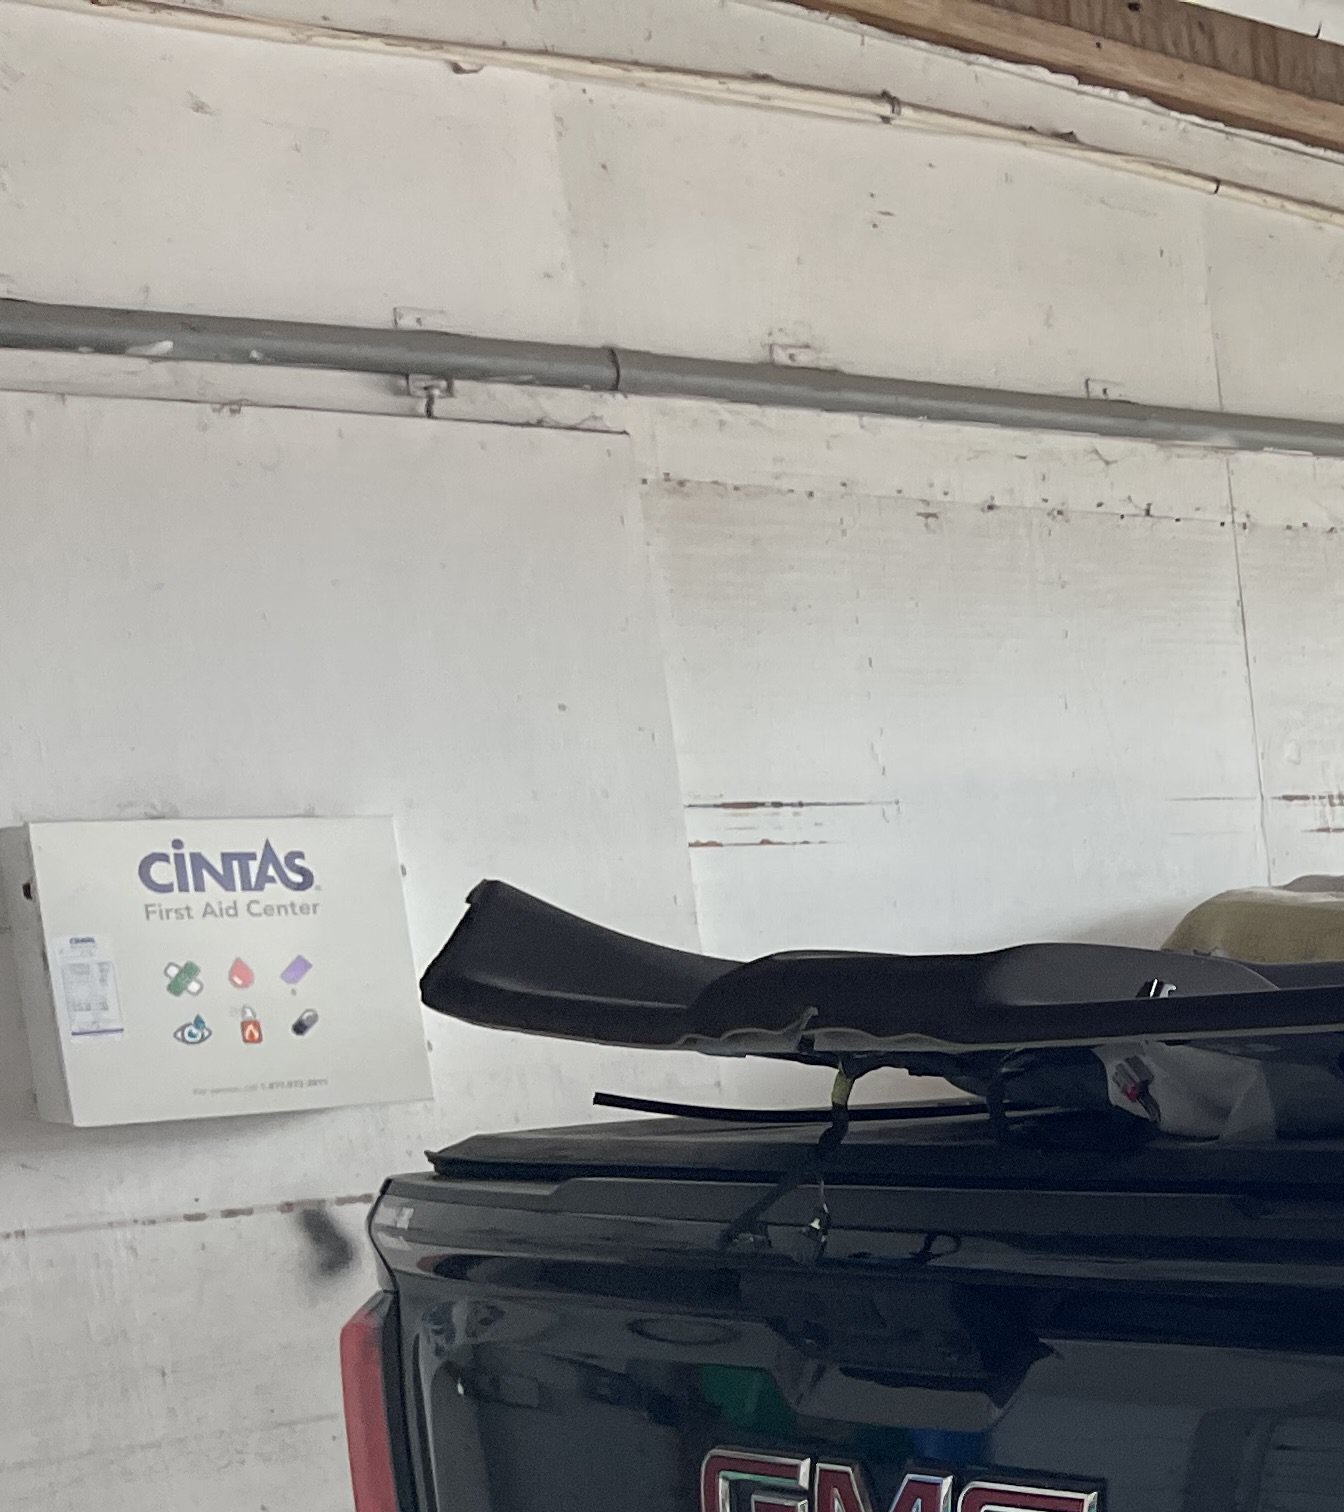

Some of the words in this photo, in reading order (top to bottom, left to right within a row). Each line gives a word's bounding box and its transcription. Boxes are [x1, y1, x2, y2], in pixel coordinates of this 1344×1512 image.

[144, 903, 194, 921] First
[202, 900, 239, 918] Aid
[246, 900, 320, 917] Center
